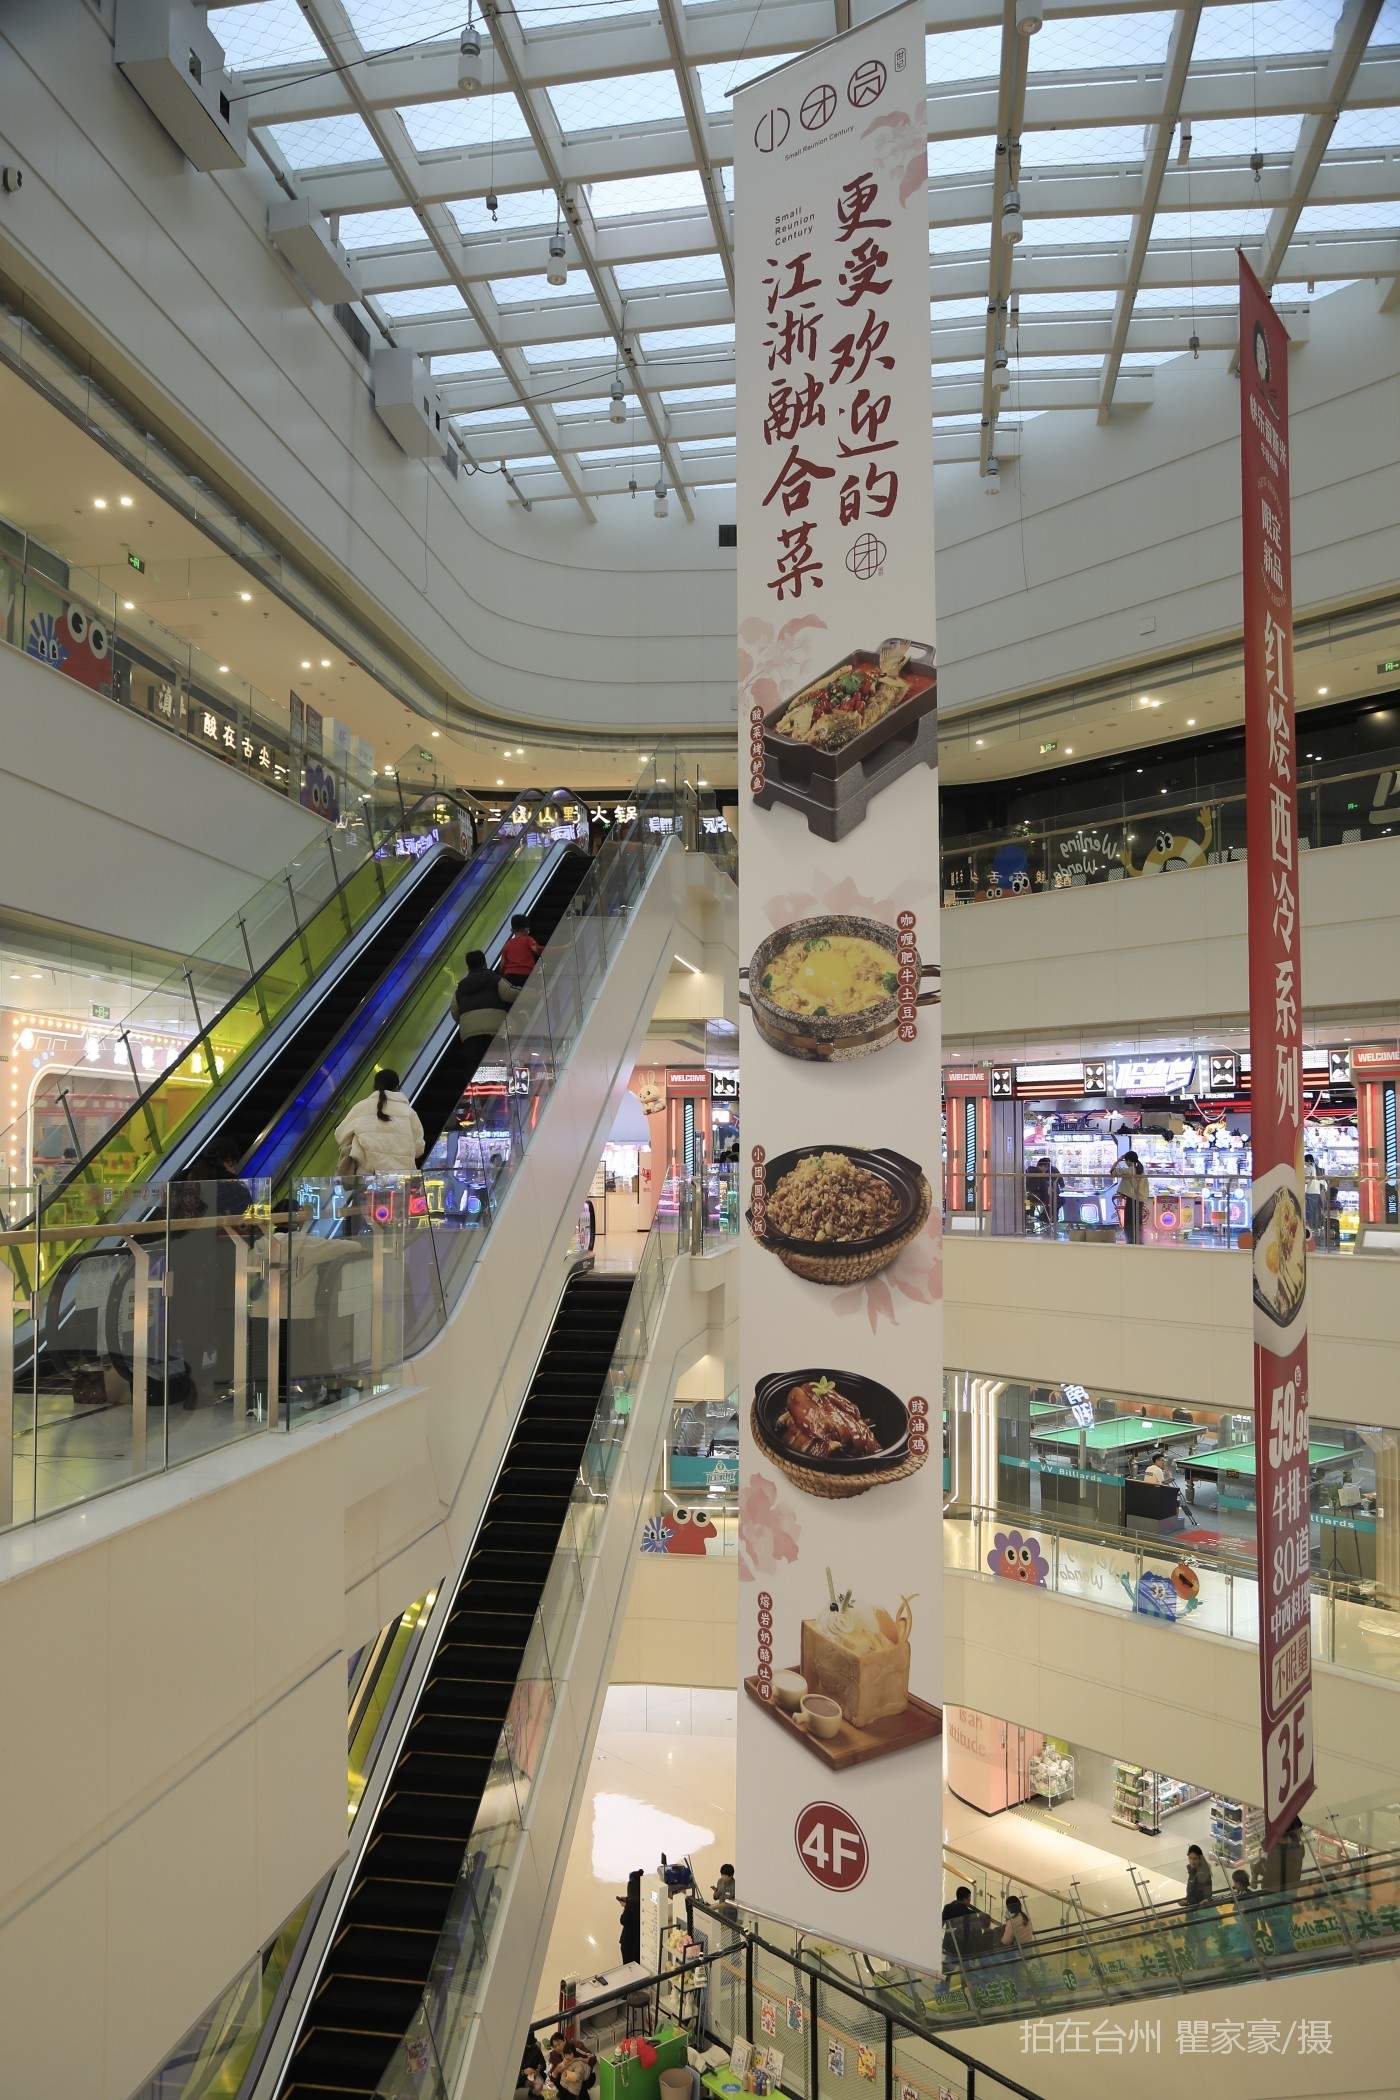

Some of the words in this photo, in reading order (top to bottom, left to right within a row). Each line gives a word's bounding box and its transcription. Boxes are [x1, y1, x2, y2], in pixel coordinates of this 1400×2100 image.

[784, 150, 802, 161] Small
[802, 136, 828, 153] Reunion
[828, 125, 855, 140] Century
[775, 206, 802, 224] Small
[775, 213, 815, 235] Reunion
[775, 226, 813, 246] Century
[829, 172, 899, 527] 更受欢迎的
[761, 252, 836, 602] 江浙融合菜
[1261, 499, 1281, 551] 限定
[1263, 540, 1283, 591] 新品
[1264, 609, 1299, 1128] 红烩西冷系列
[899, 913, 915, 1037] 咖喱肥牛土豆泥
[670, 1073, 706, 1082] WELCOME
[949, 1073, 985, 1081] WELCOME
[1358, 1052, 1400, 1063] WELCOME
[1388, 1194, 1397, 1213] 100%
[911, 1400, 926, 1452] 豉油鸡
[1059, 1468, 1102, 1482] Billiards
[1310, 1514, 1355, 1529] lliards
[1272, 1524, 1309, 1596] 80道
[1270, 1581, 1311, 1643] 中西料理
[1274, 1635, 1309, 1699] 不限量
[1278, 1702, 1305, 1804] 3F
[802, 1822, 860, 1874] 4F
